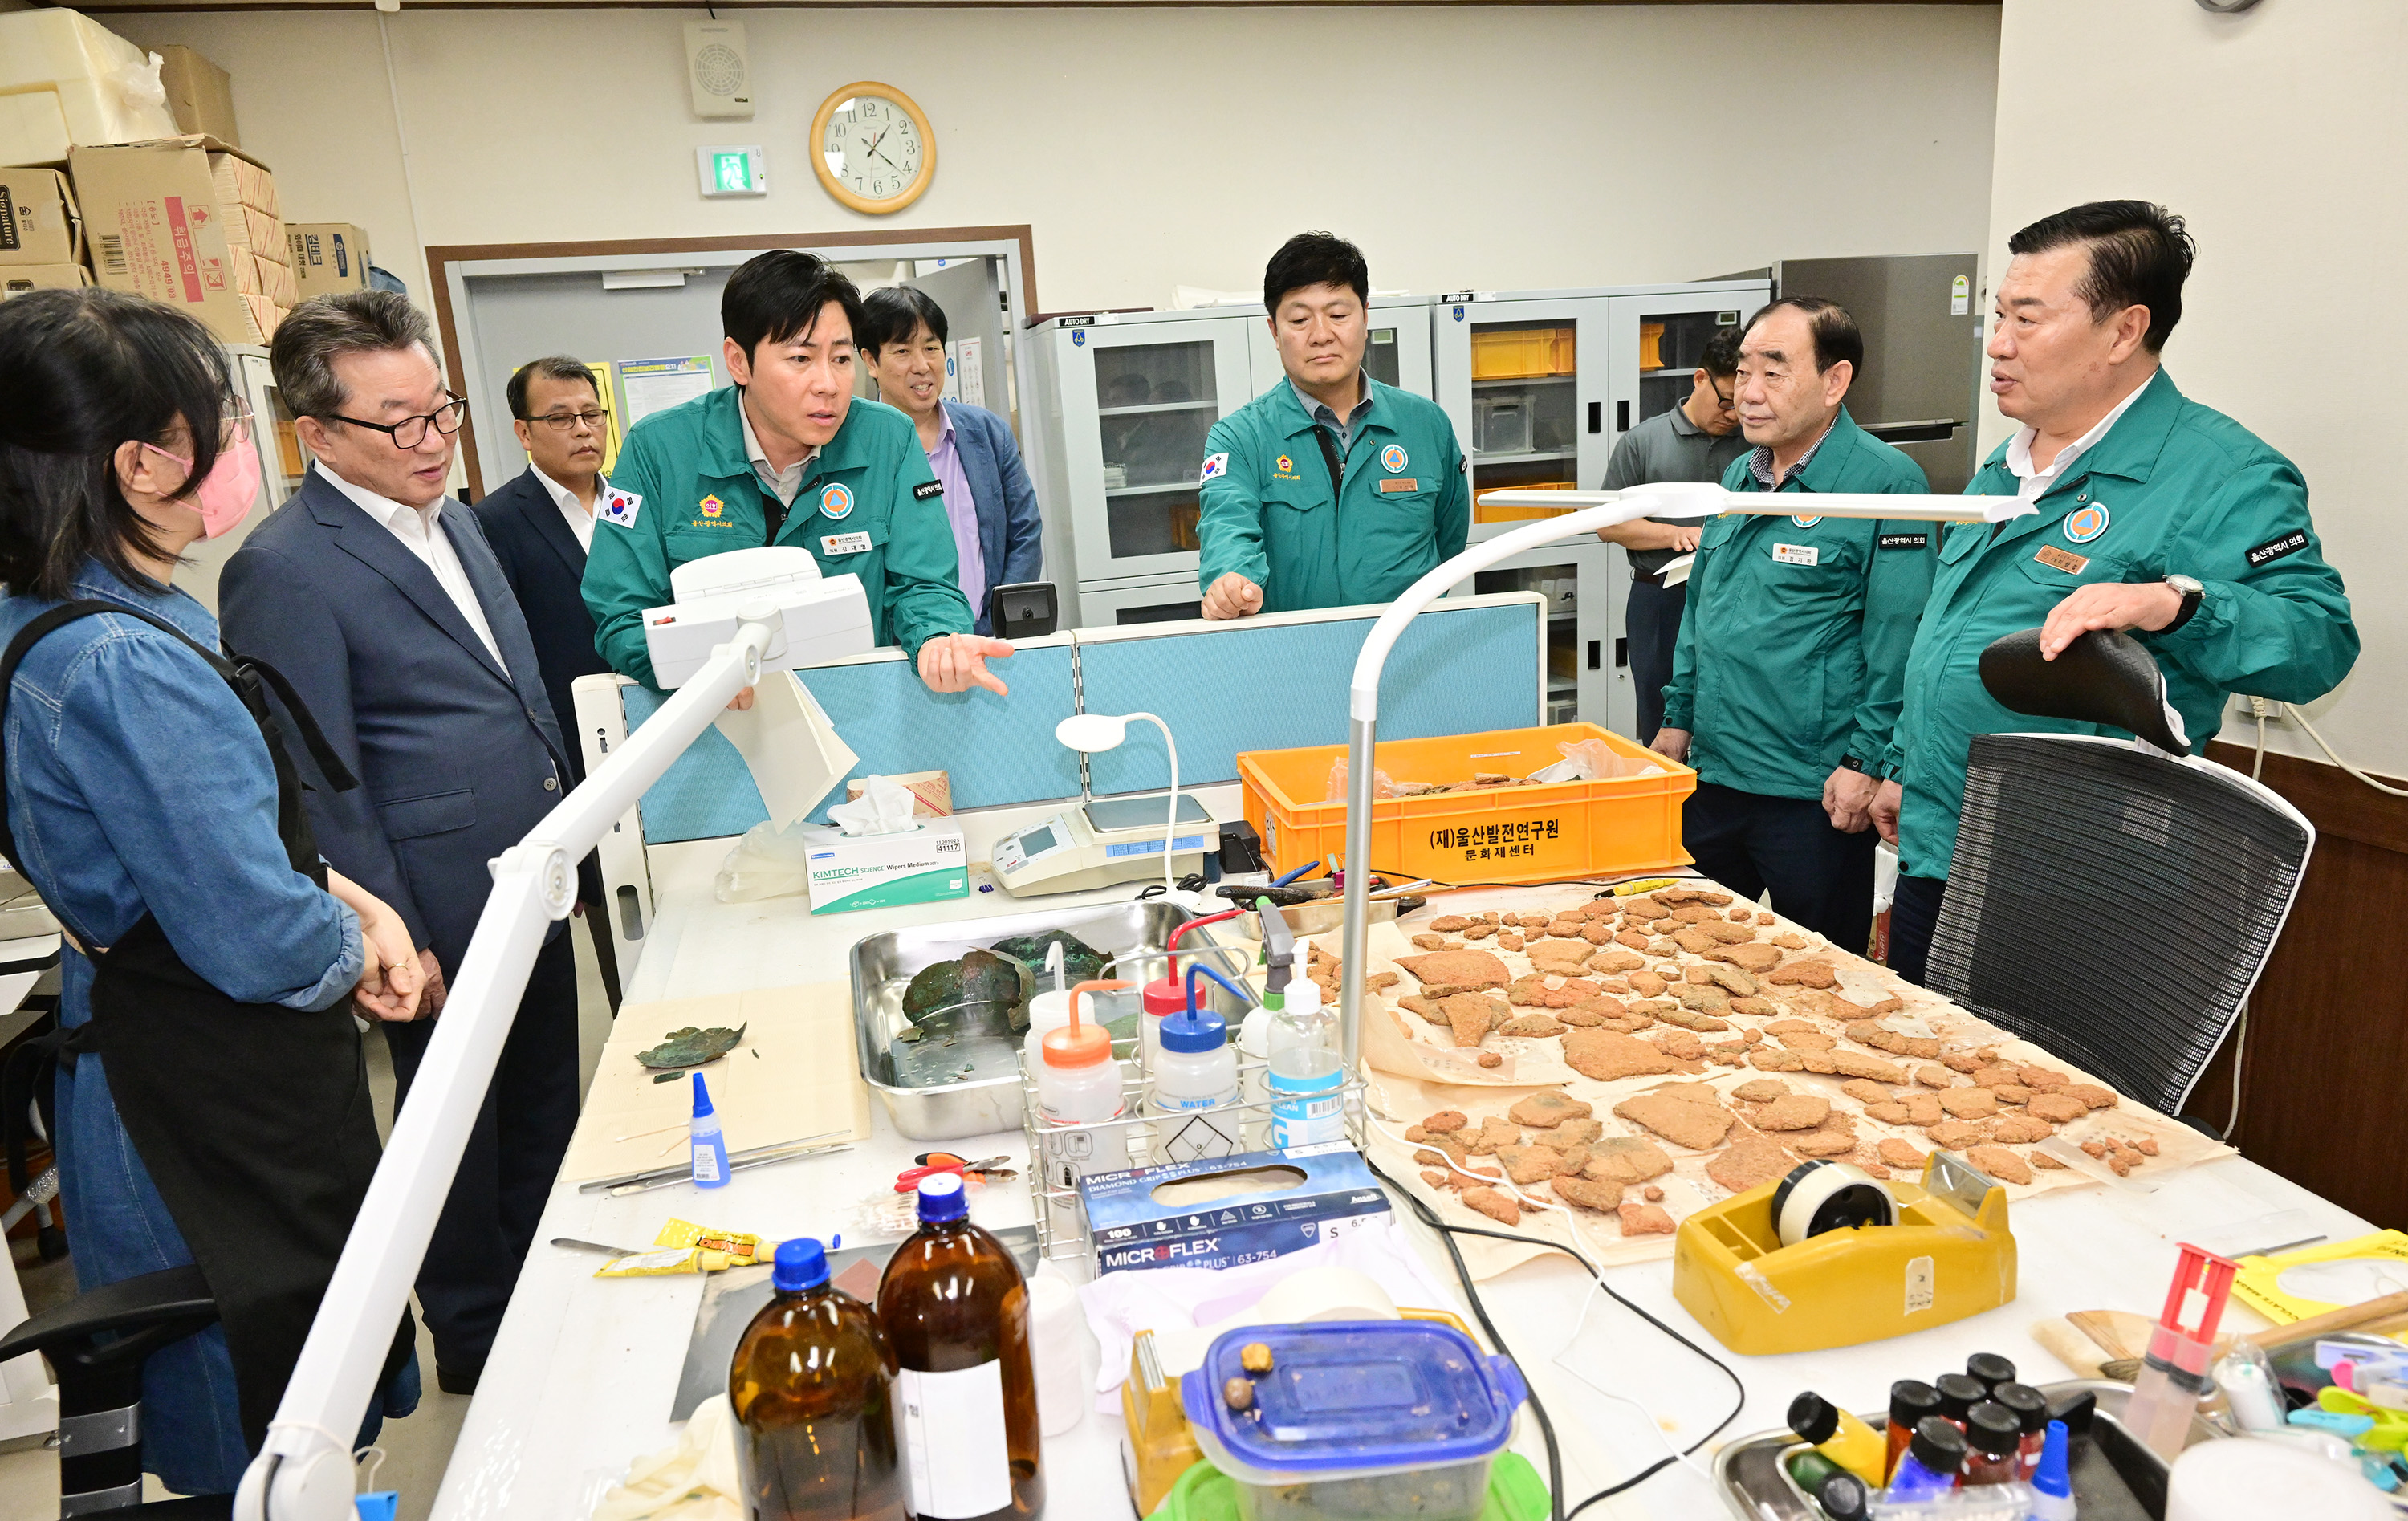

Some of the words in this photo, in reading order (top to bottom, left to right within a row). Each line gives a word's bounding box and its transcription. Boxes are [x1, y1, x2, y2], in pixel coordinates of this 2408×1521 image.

[847, 109, 857, 123] 11
[862, 103, 877, 117] 12
[885, 107, 891, 121] 1
[835, 123, 846, 137] 10
[899, 120, 908, 135] 2
[906, 140, 915, 155] 3
[902, 161, 912, 173] 4
[855, 177, 863, 190] 7
[873, 180, 882, 194] 6
[891, 175, 900, 190] 5
[173, 226, 196, 275] 취급주의
[308, 234, 323, 266] 킴테크
[161, 260, 173, 285] 4949
[1064, 318, 1080, 326] AUTO
[1080, 317, 1090, 325] DRY
[1881, 536, 1912, 545] 울산광역시
[1913, 536, 1926, 544] 의회
[2251, 540, 2289, 563] 울산광역시
[2288, 534, 2305, 547] 의회
[1430, 819, 1559, 849] (재)울산발전연구원
[938, 844, 958, 852] 41117
[1465, 844, 1535, 861] 문화재센터
[812, 866, 859, 879] KIMTECH
[860, 865, 885, 874] SCIENCE
[1180, 1098, 1216, 1108] WATER
[1088, 1179, 1137, 1193] DIAMOND
[1139, 1174, 1161, 1183] GRIP
[1210, 1161, 1247, 1171] 63-754
[1107, 1228, 1132, 1238] 100
[1330, 1227, 1339, 1238] S
[1237, 1249, 1278, 1265] 63-754
